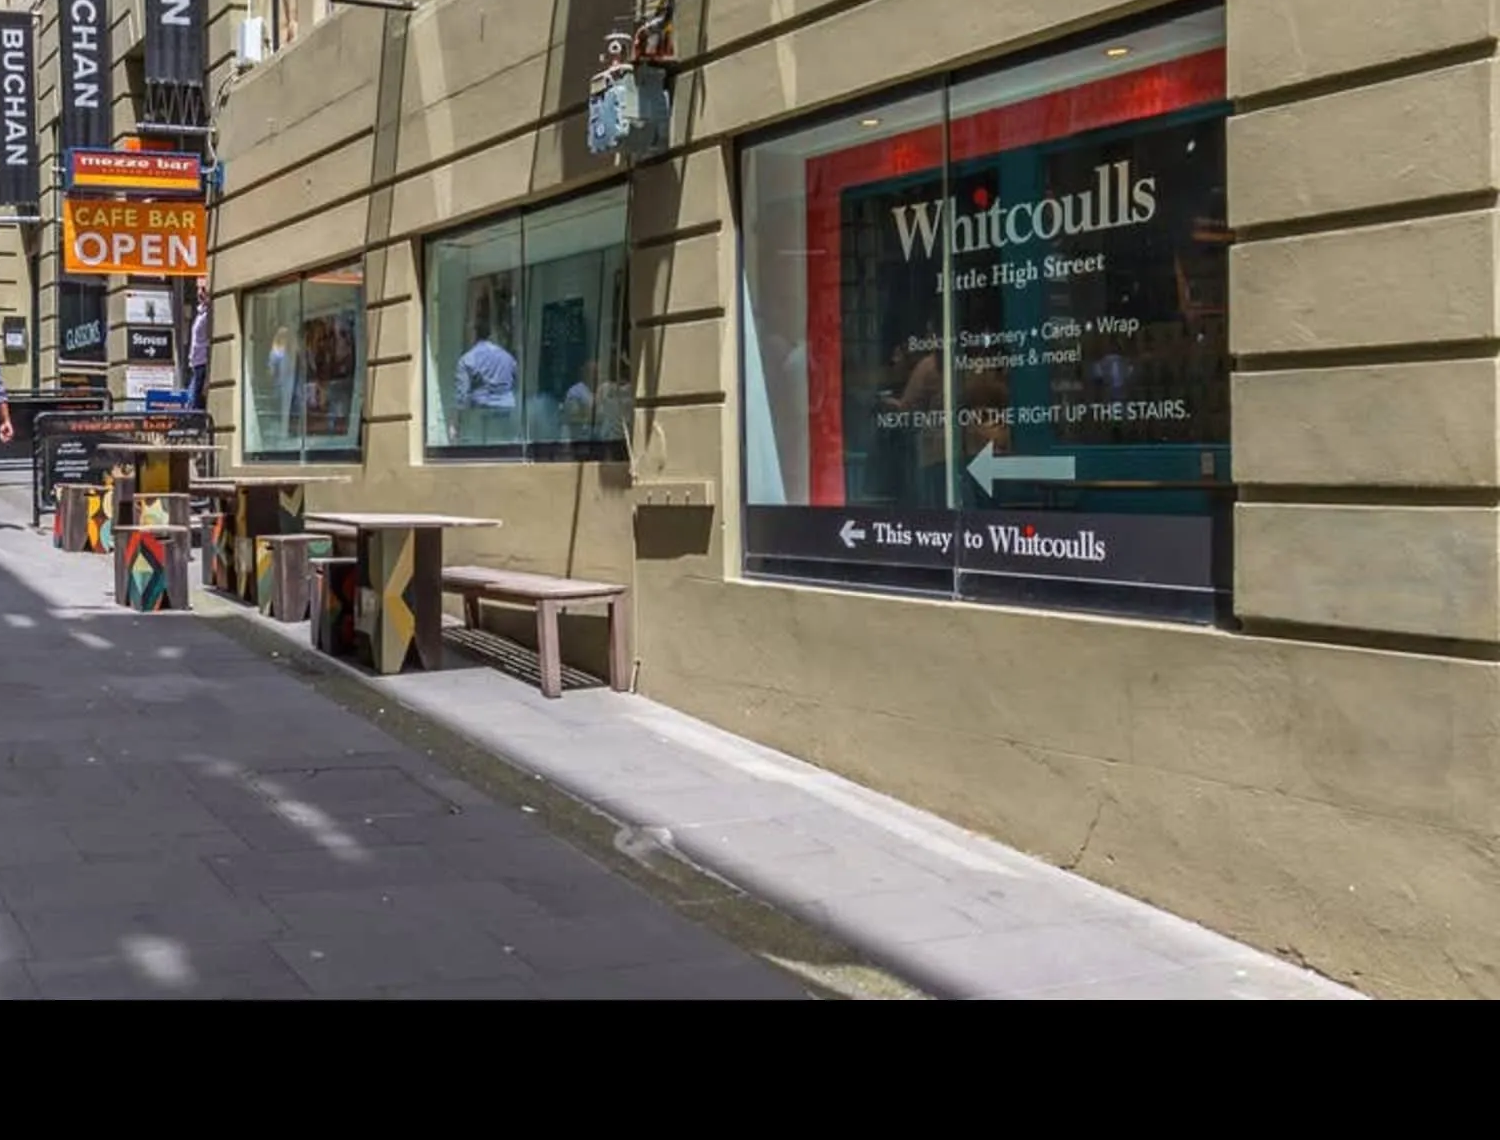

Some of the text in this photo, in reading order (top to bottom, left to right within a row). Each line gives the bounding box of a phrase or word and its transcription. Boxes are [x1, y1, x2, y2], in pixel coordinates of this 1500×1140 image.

[1, 27, 28, 166] BUCHAN
[80, 156, 192, 171] mezze bar
[74, 207, 197, 229] CAFE BAR
[891, 160, 1157, 262] Whitcoulls
[73, 231, 198, 267] OPEN
[935, 252, 1106, 294] Lttle High Street
[958, 327, 1028, 349] Stationery
[1040, 320, 1083, 340] Cards
[1096, 315, 1141, 337] Wrap
[955, 345, 1083, 375] Magazines & more!
[877, 399, 1191, 429] NEXT ENTR ON THE RIGHT UP THE STAIRS.
[872, 521, 1107, 562] This way to Whitcoulls
